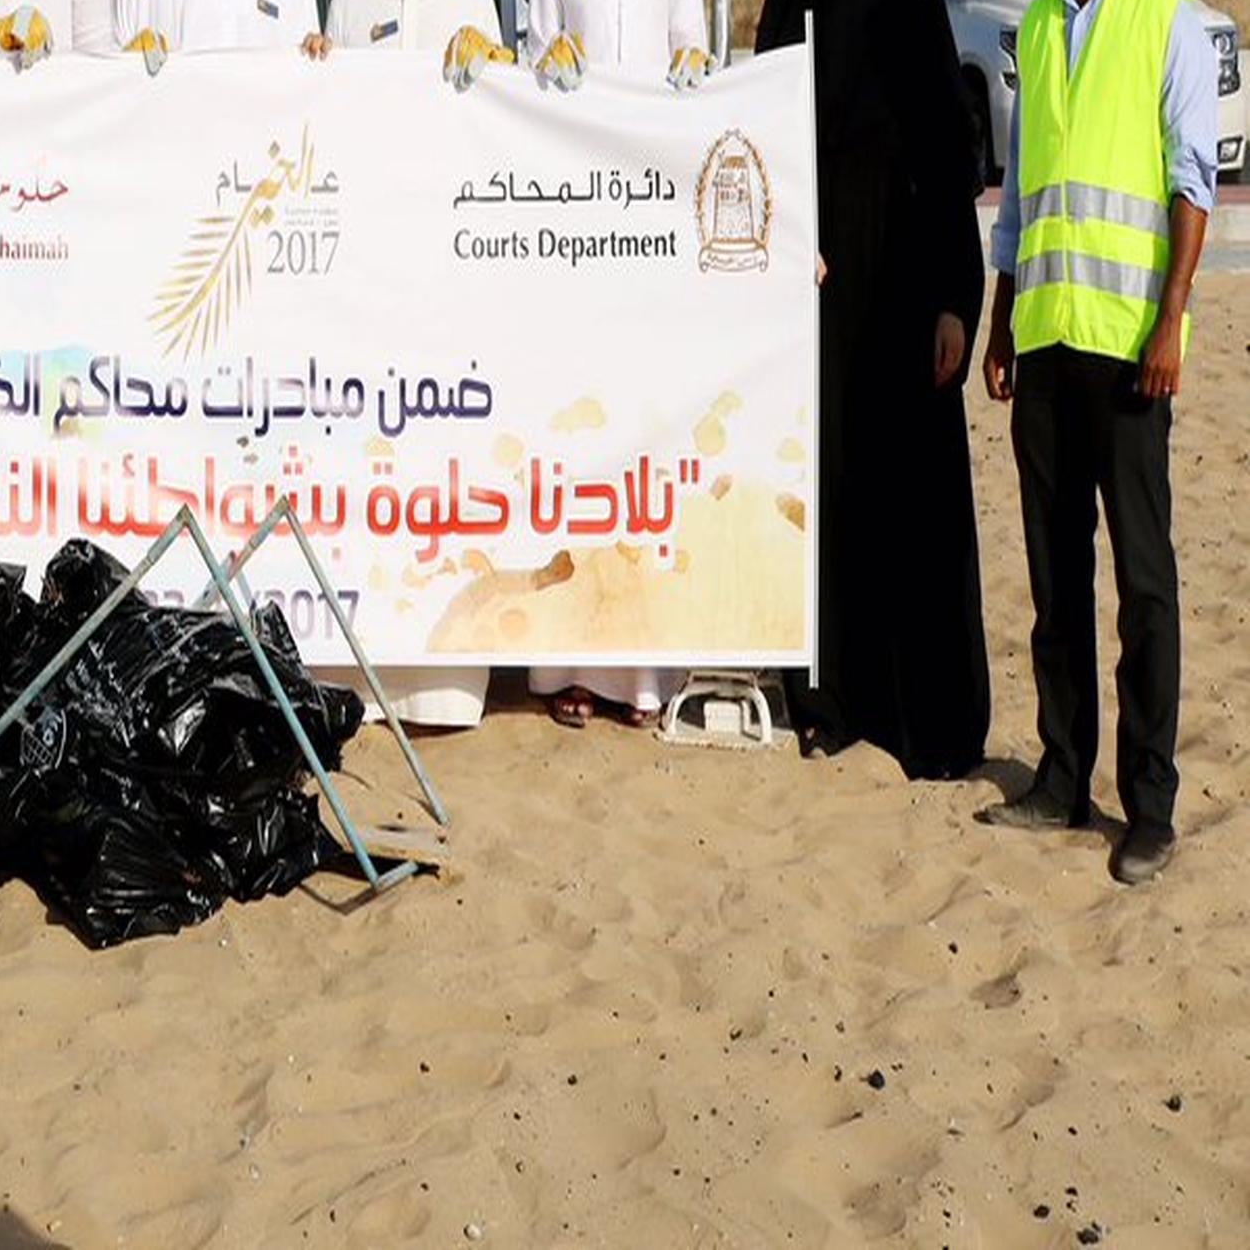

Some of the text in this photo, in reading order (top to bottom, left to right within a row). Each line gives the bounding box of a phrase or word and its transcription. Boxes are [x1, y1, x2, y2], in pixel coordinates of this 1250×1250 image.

[453, 168, 676, 210] دائرة المحاكم
[267, 229, 340, 275] 2017
[454, 228, 530, 260] Courts
[538, 228, 677, 268] Department
[53, 355, 188, 436] محاكم
[202, 356, 365, 437] مبادرات
[378, 360, 492, 437] ضمن
[367, 456, 510, 563] حلوة
